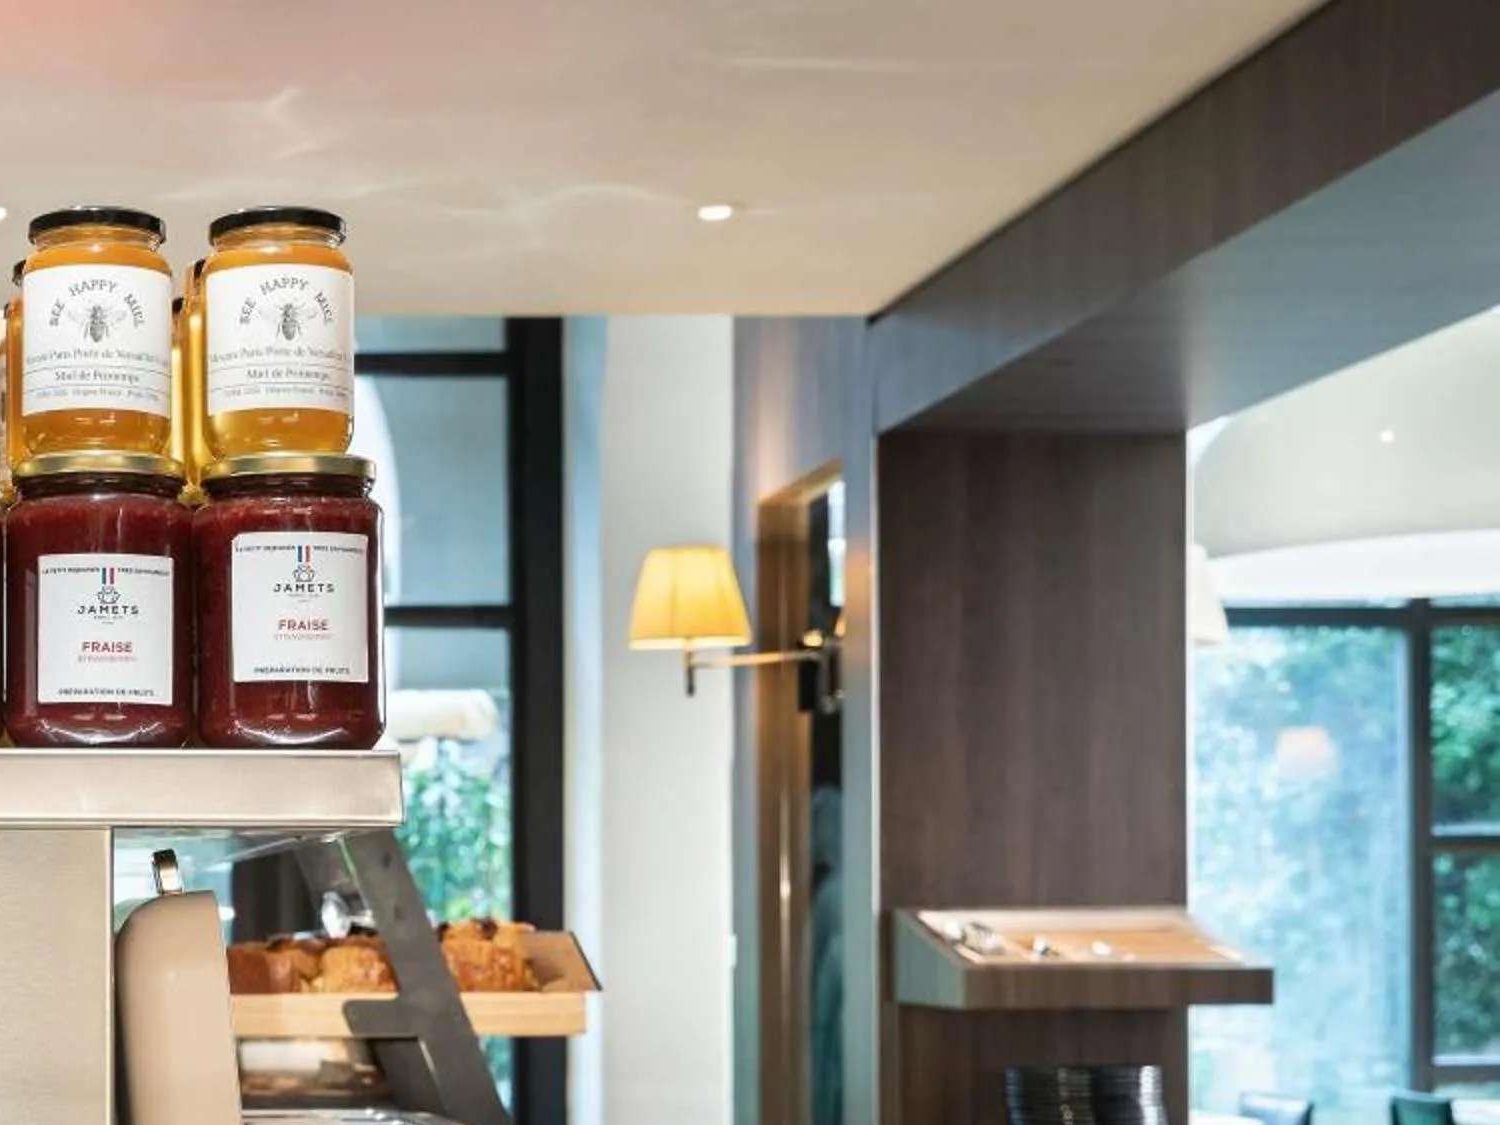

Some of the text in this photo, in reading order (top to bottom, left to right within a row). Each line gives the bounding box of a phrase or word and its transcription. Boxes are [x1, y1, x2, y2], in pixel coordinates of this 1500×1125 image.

[49, 279, 145, 328] BEE HAPPY MIEL
[239, 277, 335, 326] BEE HAPPY MIEL
[273, 583, 335, 593] JAMETS
[77, 605, 139, 615] JAMETS
[278, 619, 330, 631] FRAISE
[81, 641, 133, 653] FRAISE
